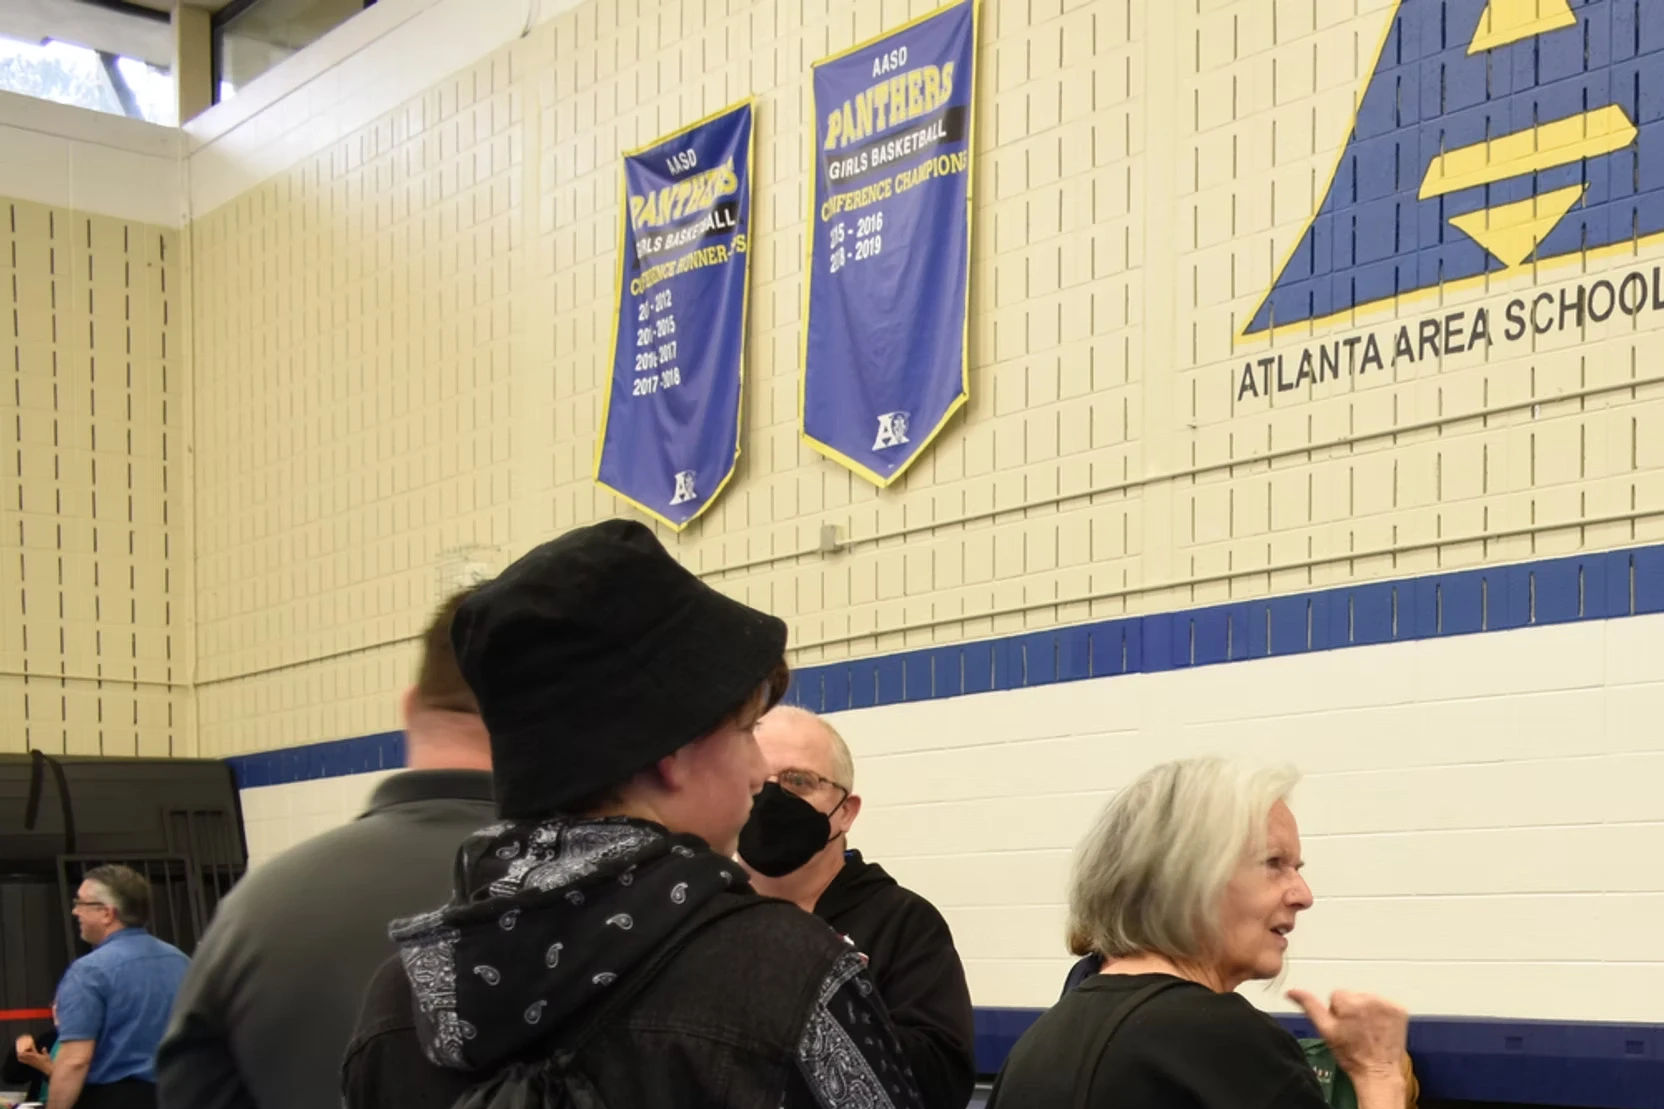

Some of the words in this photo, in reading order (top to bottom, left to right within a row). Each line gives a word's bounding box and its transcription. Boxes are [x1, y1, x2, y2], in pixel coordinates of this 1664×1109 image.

[872, 46, 908, 78] AASD
[824, 60, 954, 150] PANTHERS
[666, 148, 697, 176] AASD
[829, 152, 868, 180] GIRLS
[871, 119, 947, 167] BASKETBALL
[856, 212, 883, 238] 2016
[855, 235, 882, 261] 2019
[1237, 332, 1384, 402] ATLANTA
[1391, 306, 1493, 368] AREA
[632, 375, 659, 396] 2017
